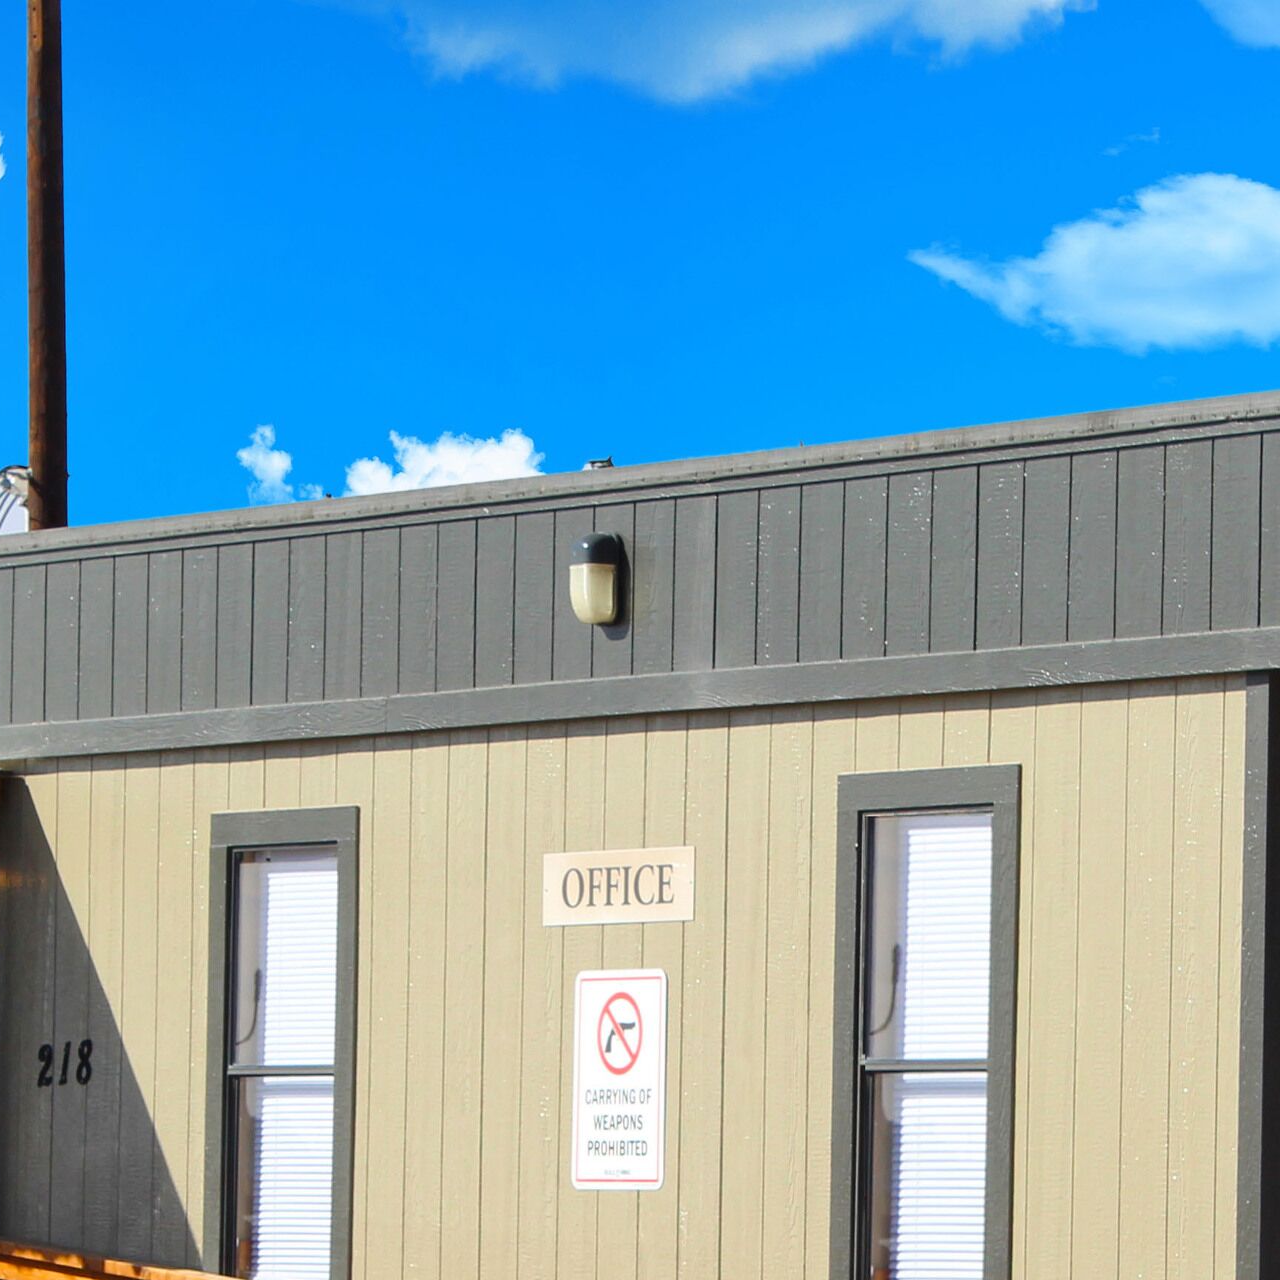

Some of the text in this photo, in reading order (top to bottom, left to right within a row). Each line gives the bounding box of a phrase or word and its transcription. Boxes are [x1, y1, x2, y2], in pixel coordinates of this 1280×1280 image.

[561, 863, 675, 909] OFFICE
[37, 1038, 93, 1088] 218
[584, 1088, 652, 1105] CARRYING OF
[593, 1114, 644, 1131] WEAPONS
[587, 1140, 649, 1157] PROHIBITED
